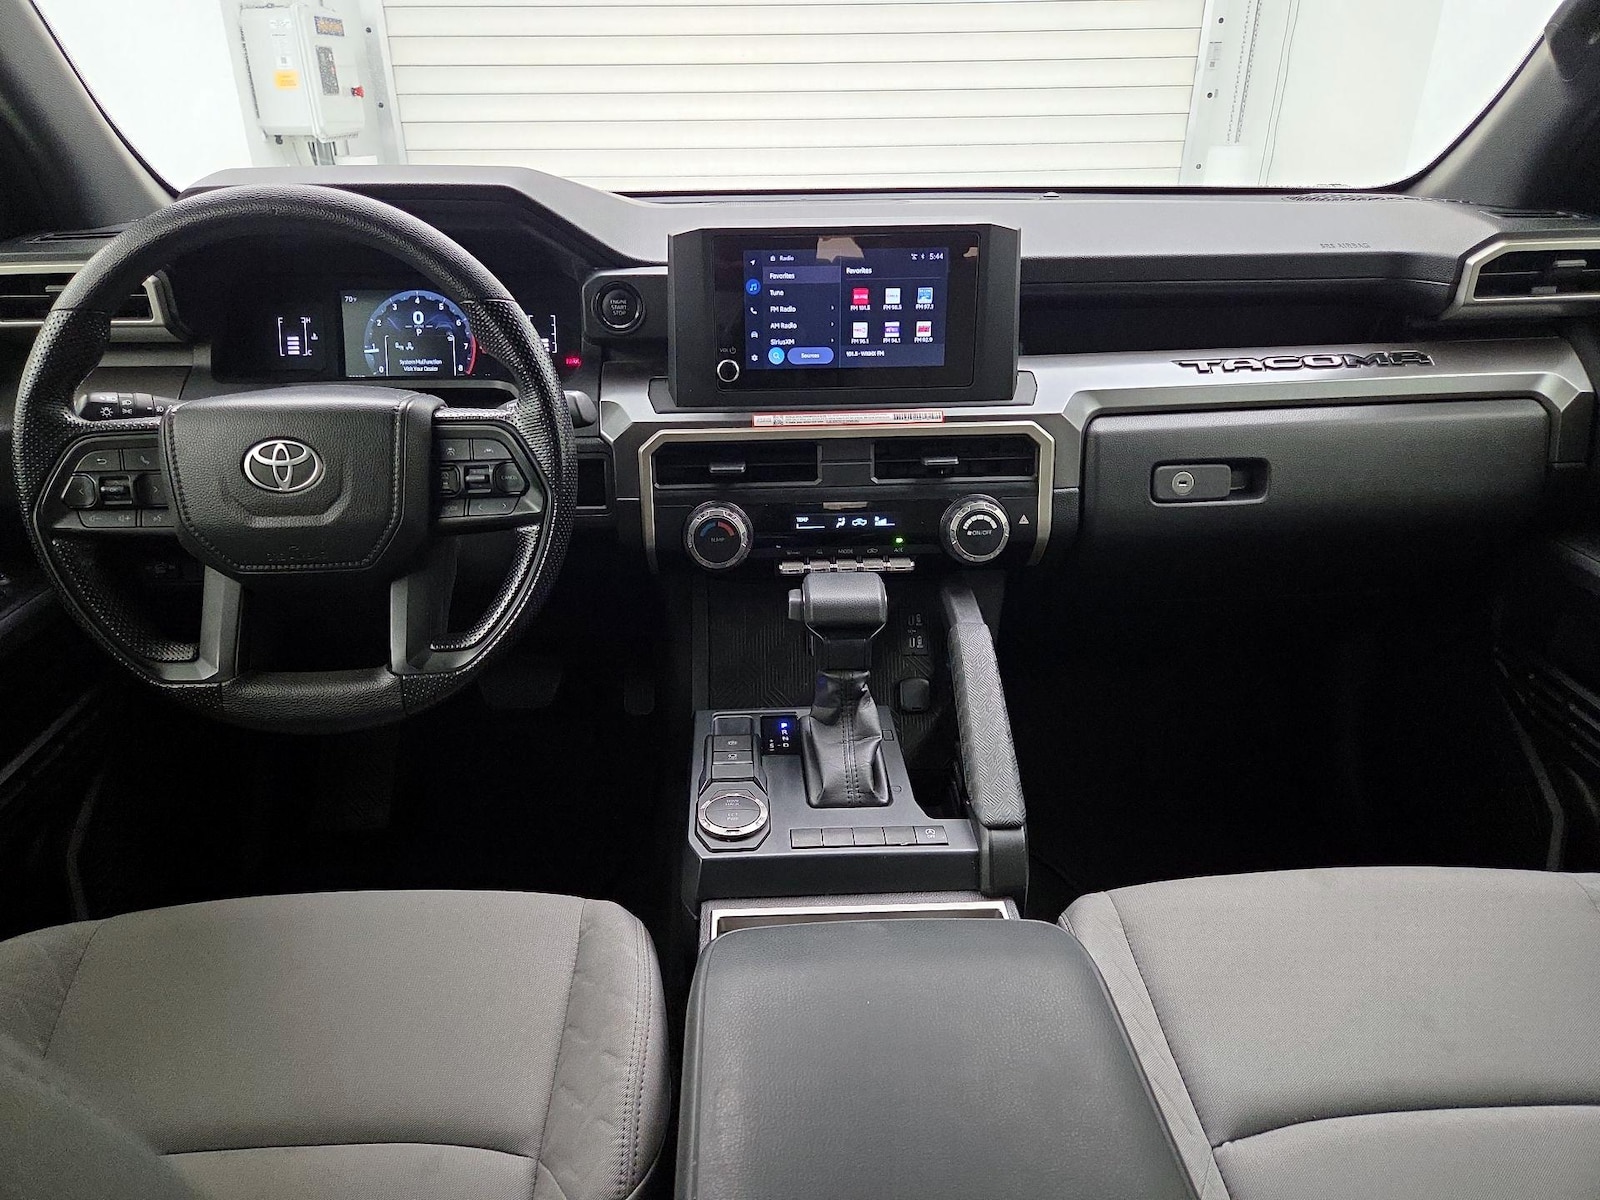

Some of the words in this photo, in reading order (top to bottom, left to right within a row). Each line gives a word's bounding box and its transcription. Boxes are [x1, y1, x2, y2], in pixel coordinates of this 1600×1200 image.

[929, 252, 944, 260] 5:44
[845, 267, 873, 275] Favorites
[769, 272, 795, 280] Favorites
[769, 289, 784, 297] Tune
[392, 303, 398, 311] 3
[770, 305, 779, 313] FM
[780, 305, 797, 313] Radio
[412, 310, 425, 325] 0
[376, 319, 382, 327] 2
[455, 319, 461, 327] 6
[770, 322, 780, 330] AM
[781, 322, 798, 330] Radio
[416, 327, 422, 337] P
[463, 342, 469, 350] 7
[770, 338, 795, 346] SiriusXM
[1171, 350, 1436, 375] TACOMA
[378, 365, 384, 373] 0
[457, 364, 463, 372] 8
